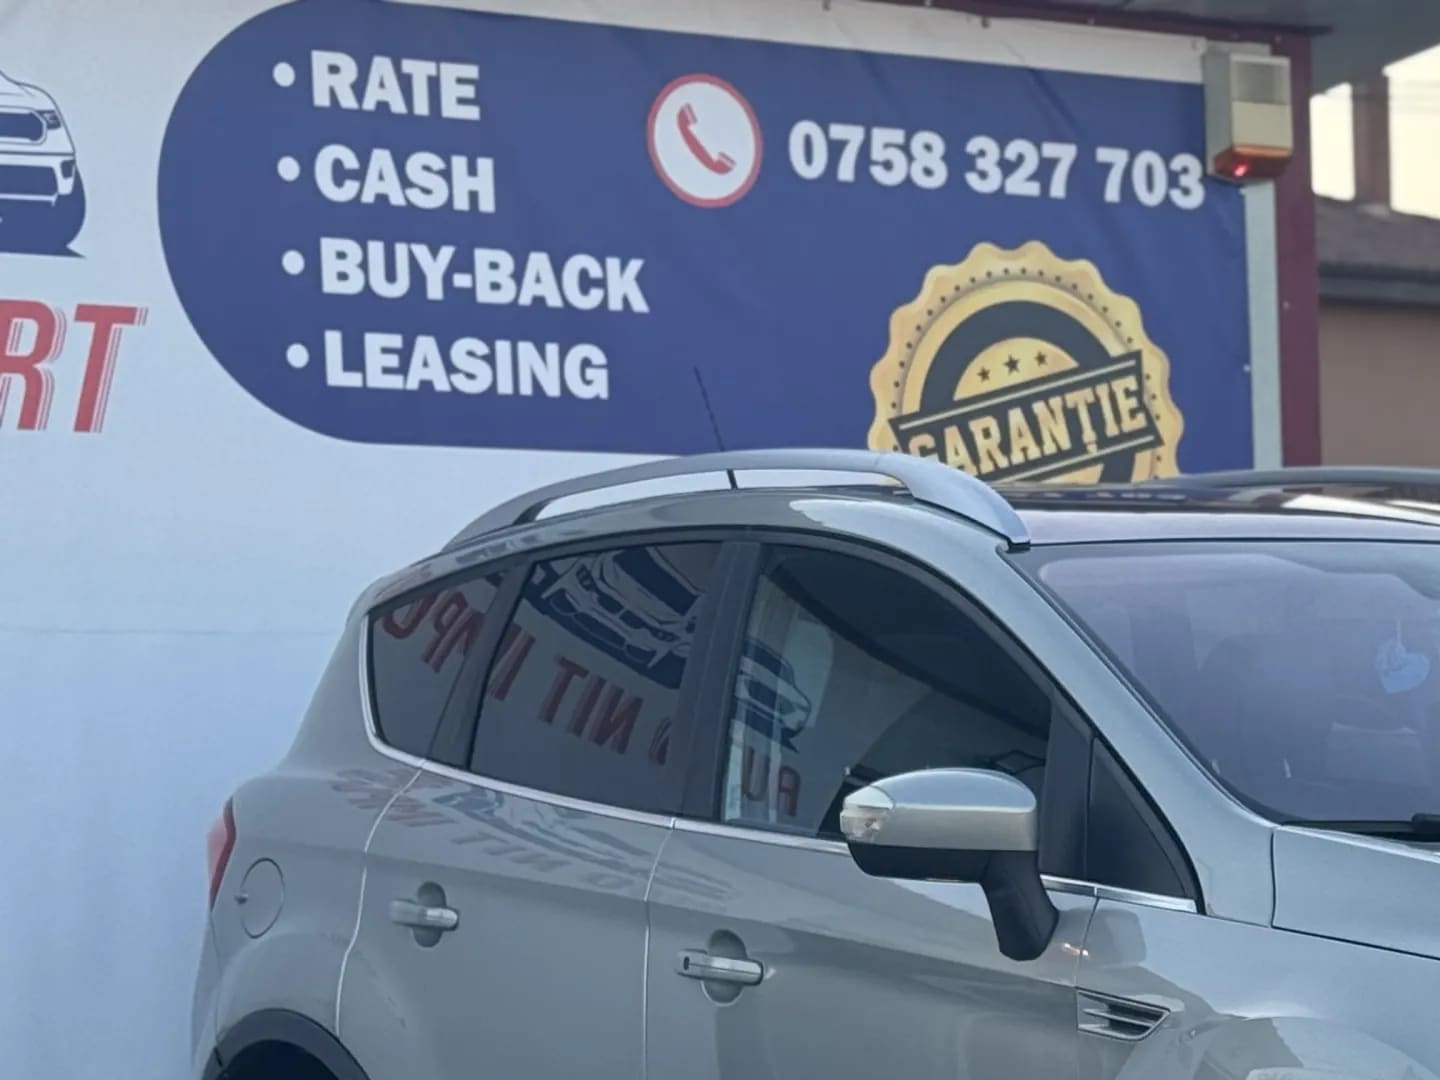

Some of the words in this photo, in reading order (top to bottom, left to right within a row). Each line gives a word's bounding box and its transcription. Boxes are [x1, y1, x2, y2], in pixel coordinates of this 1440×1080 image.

[311, 49, 480, 121] RATE
[315, 144, 495, 213] CASH
[788, 119, 948, 190] 0758
[964, 135, 1077, 200] 327
[1096, 145, 1206, 211] 703
[320, 237, 649, 313] BUY-BACK
[324, 330, 609, 400] LEASING
